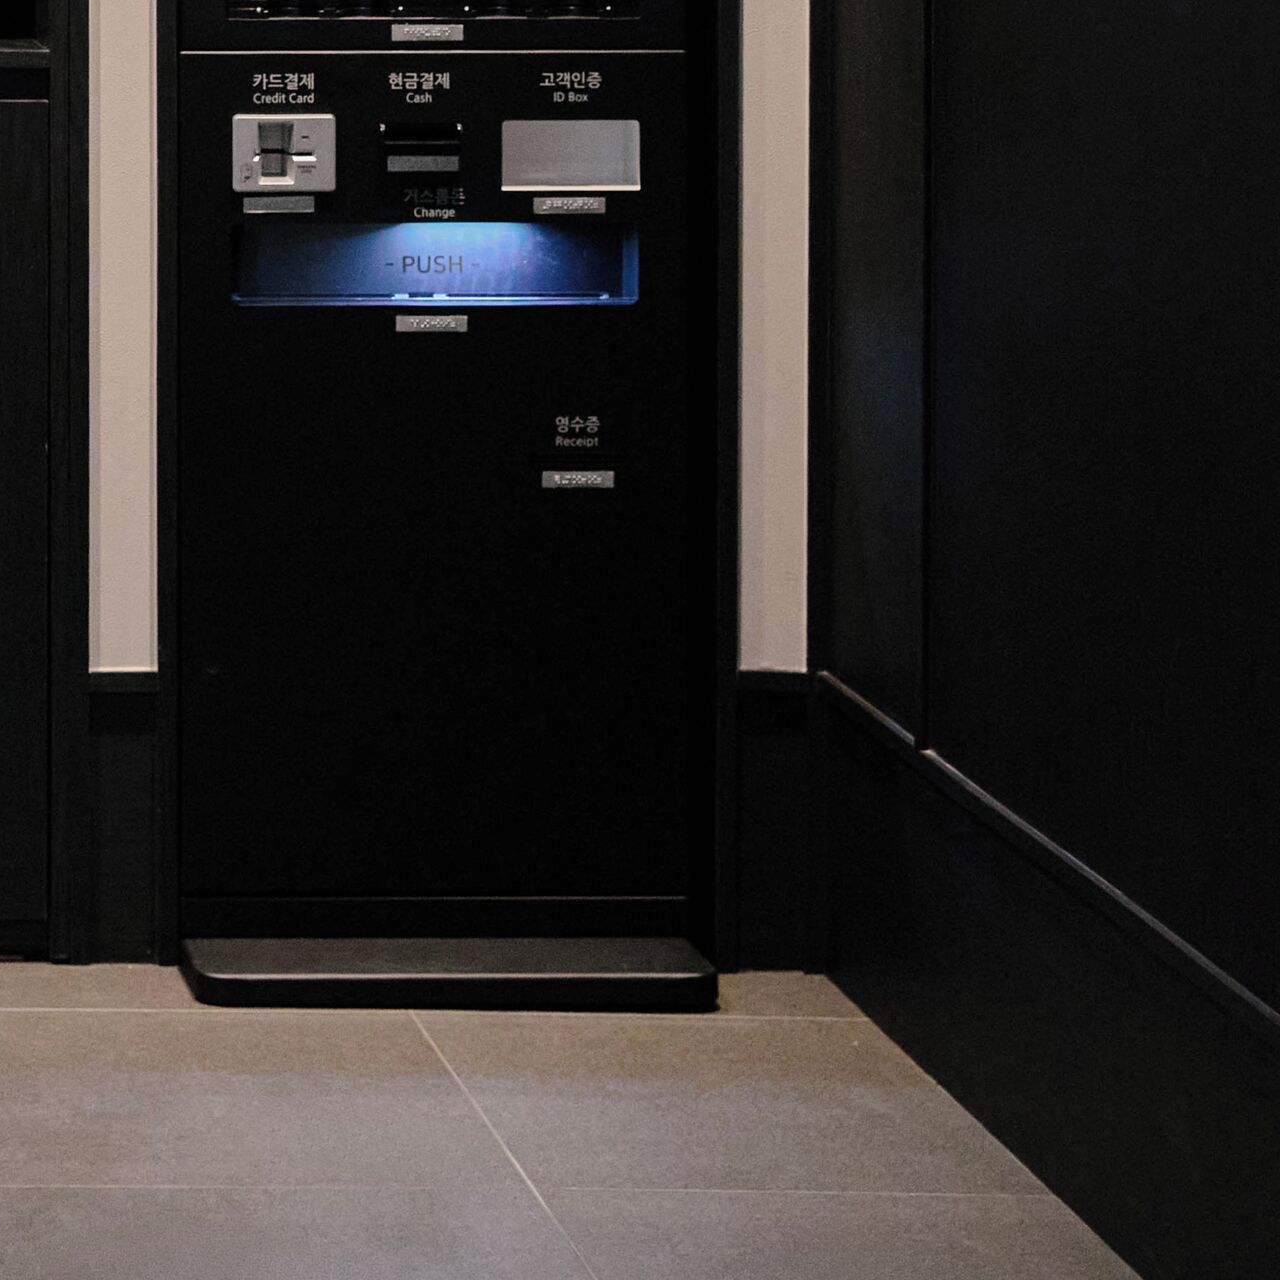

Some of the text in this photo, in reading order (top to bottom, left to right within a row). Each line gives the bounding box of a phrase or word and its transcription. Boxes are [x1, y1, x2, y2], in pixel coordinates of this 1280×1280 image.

[252, 72, 315, 91] 카드결제
[388, 72, 450, 90] 현금결제
[539, 71, 602, 89] 고객인증
[252, 92, 315, 104] Credit Card
[406, 91, 432, 103] Cash
[553, 91, 589, 102] ID Box
[413, 207, 456, 219] Change
[402, 255, 463, 273] PUSH
[555, 416, 600, 433] 영수증
[555, 435, 599, 448] Receipt
